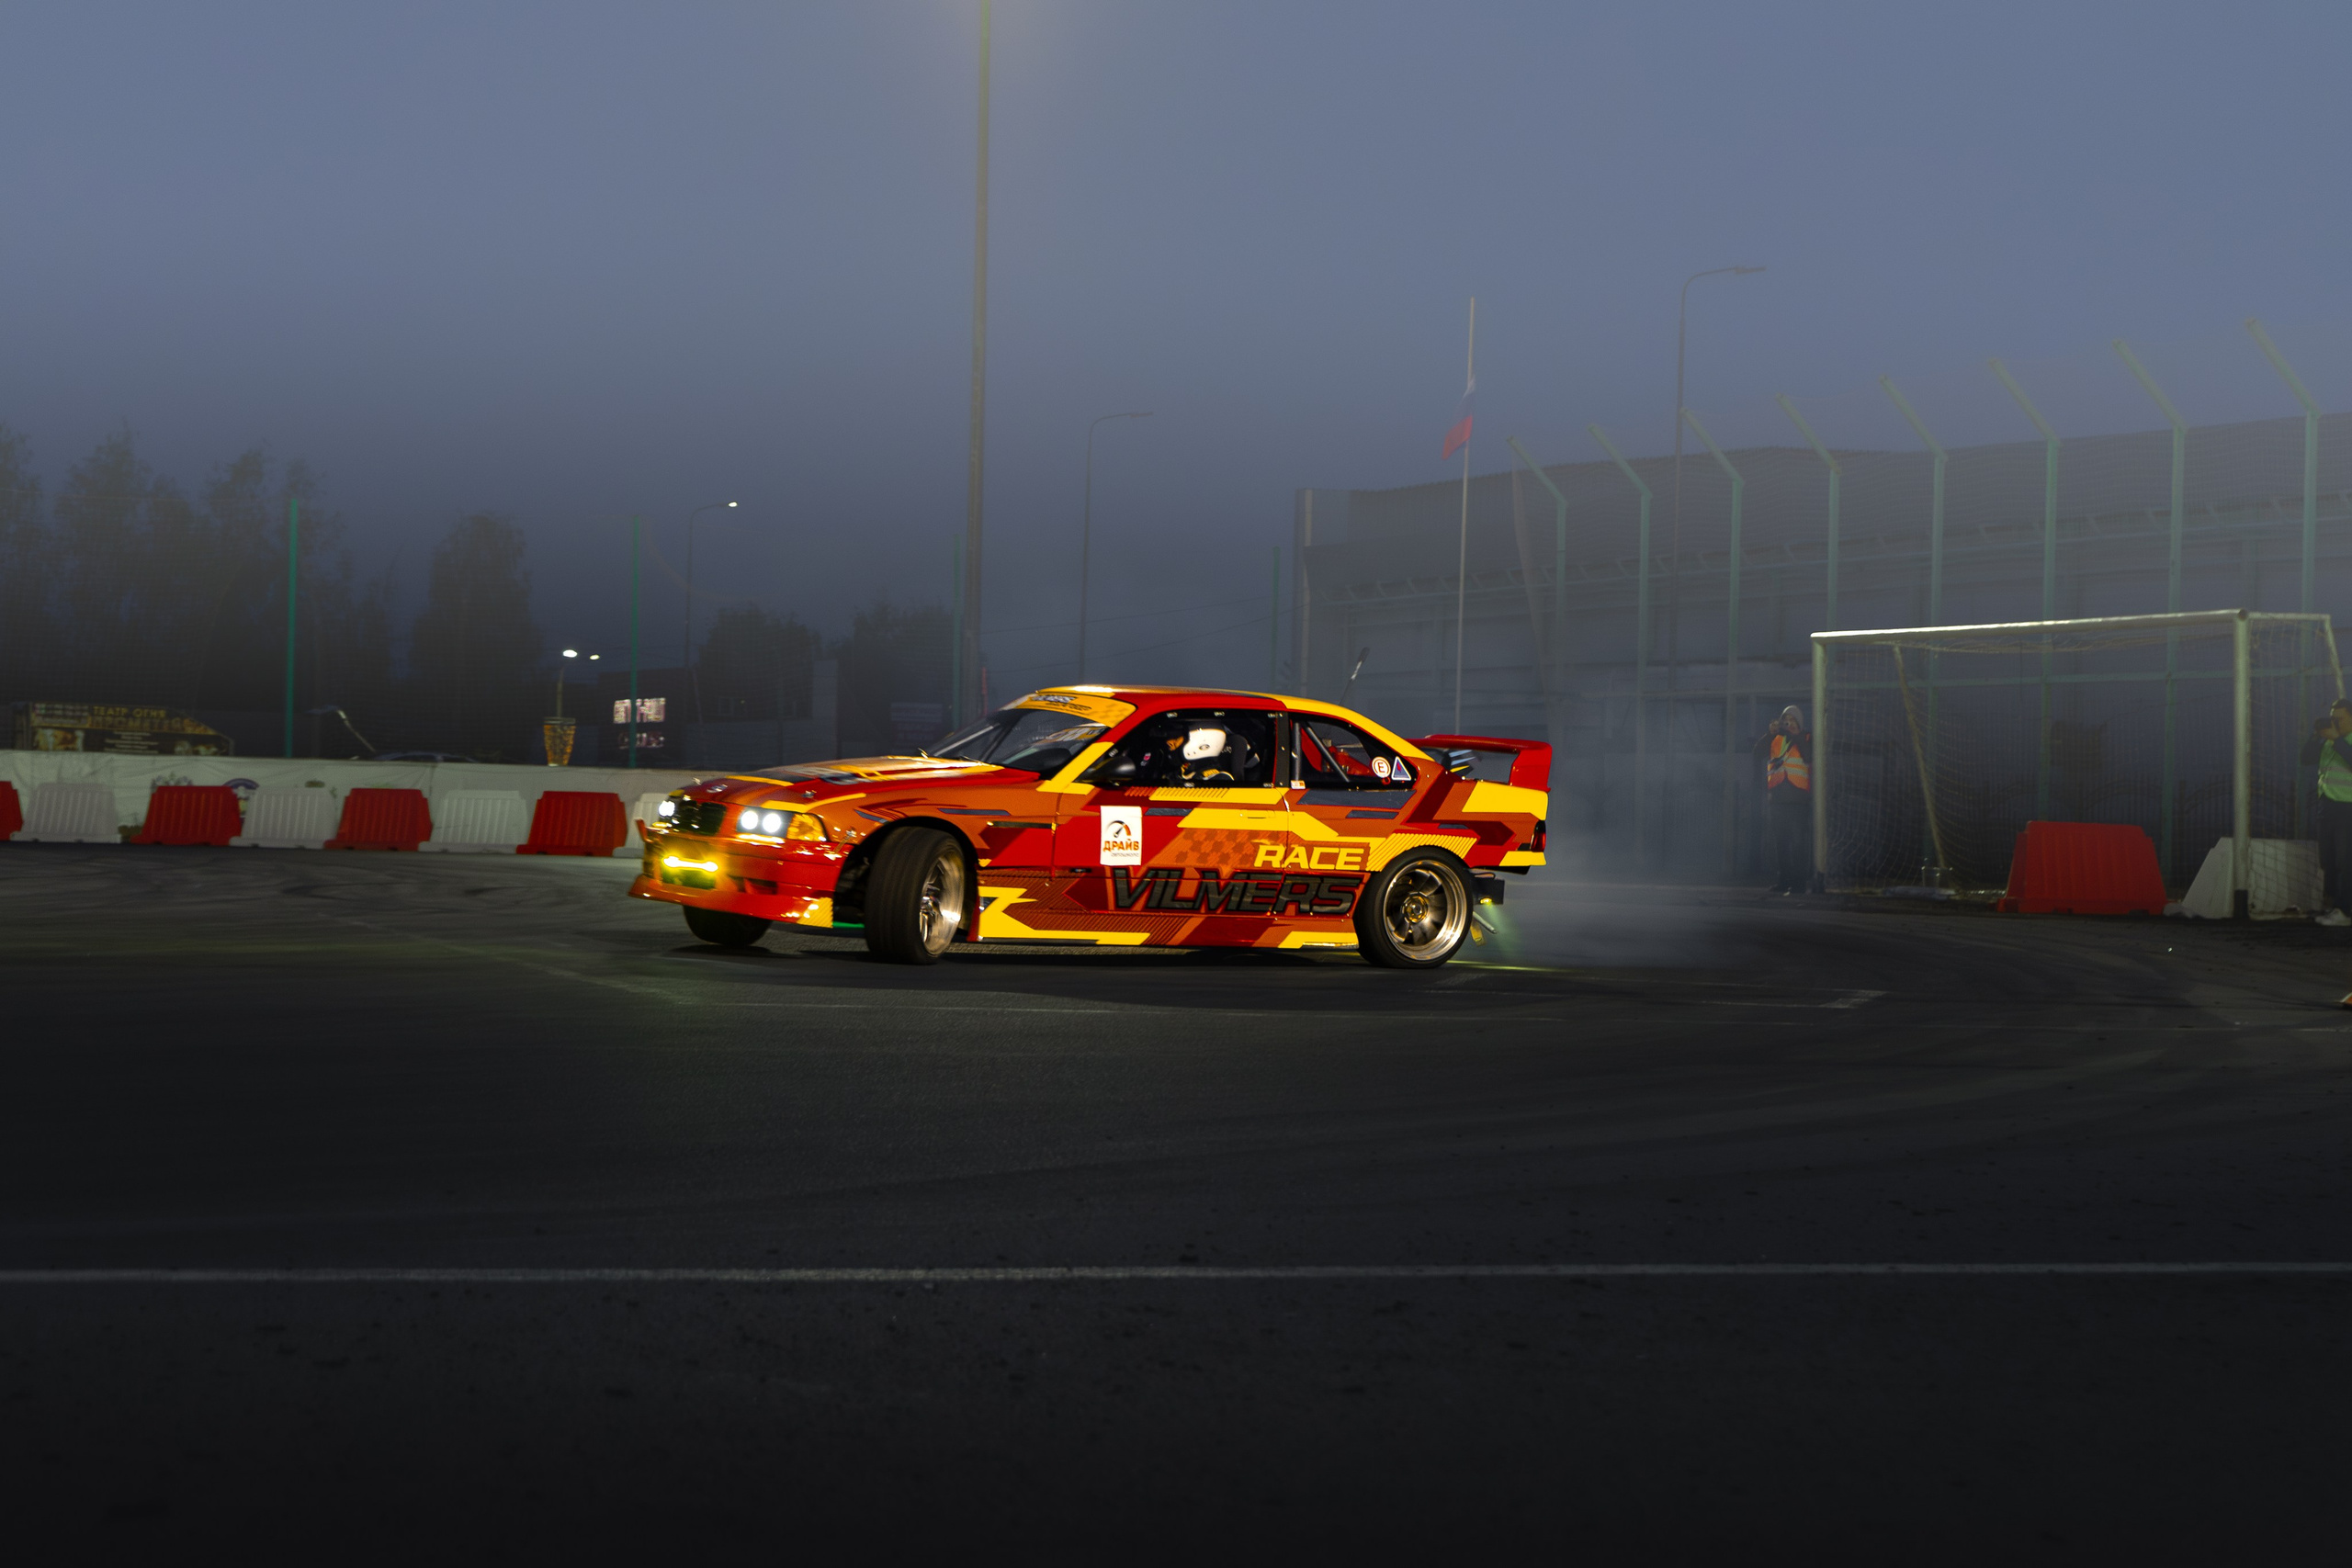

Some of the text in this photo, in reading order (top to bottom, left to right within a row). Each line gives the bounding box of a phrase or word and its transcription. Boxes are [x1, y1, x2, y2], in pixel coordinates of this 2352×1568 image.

[93, 705, 129, 716] ТЕАТР
[1377, 761, 1385, 773] E
[1102, 838, 1140, 852] ДРАЙВ
[1252, 843, 1364, 871] RACE
[1112, 867, 1365, 914] VILMERS
